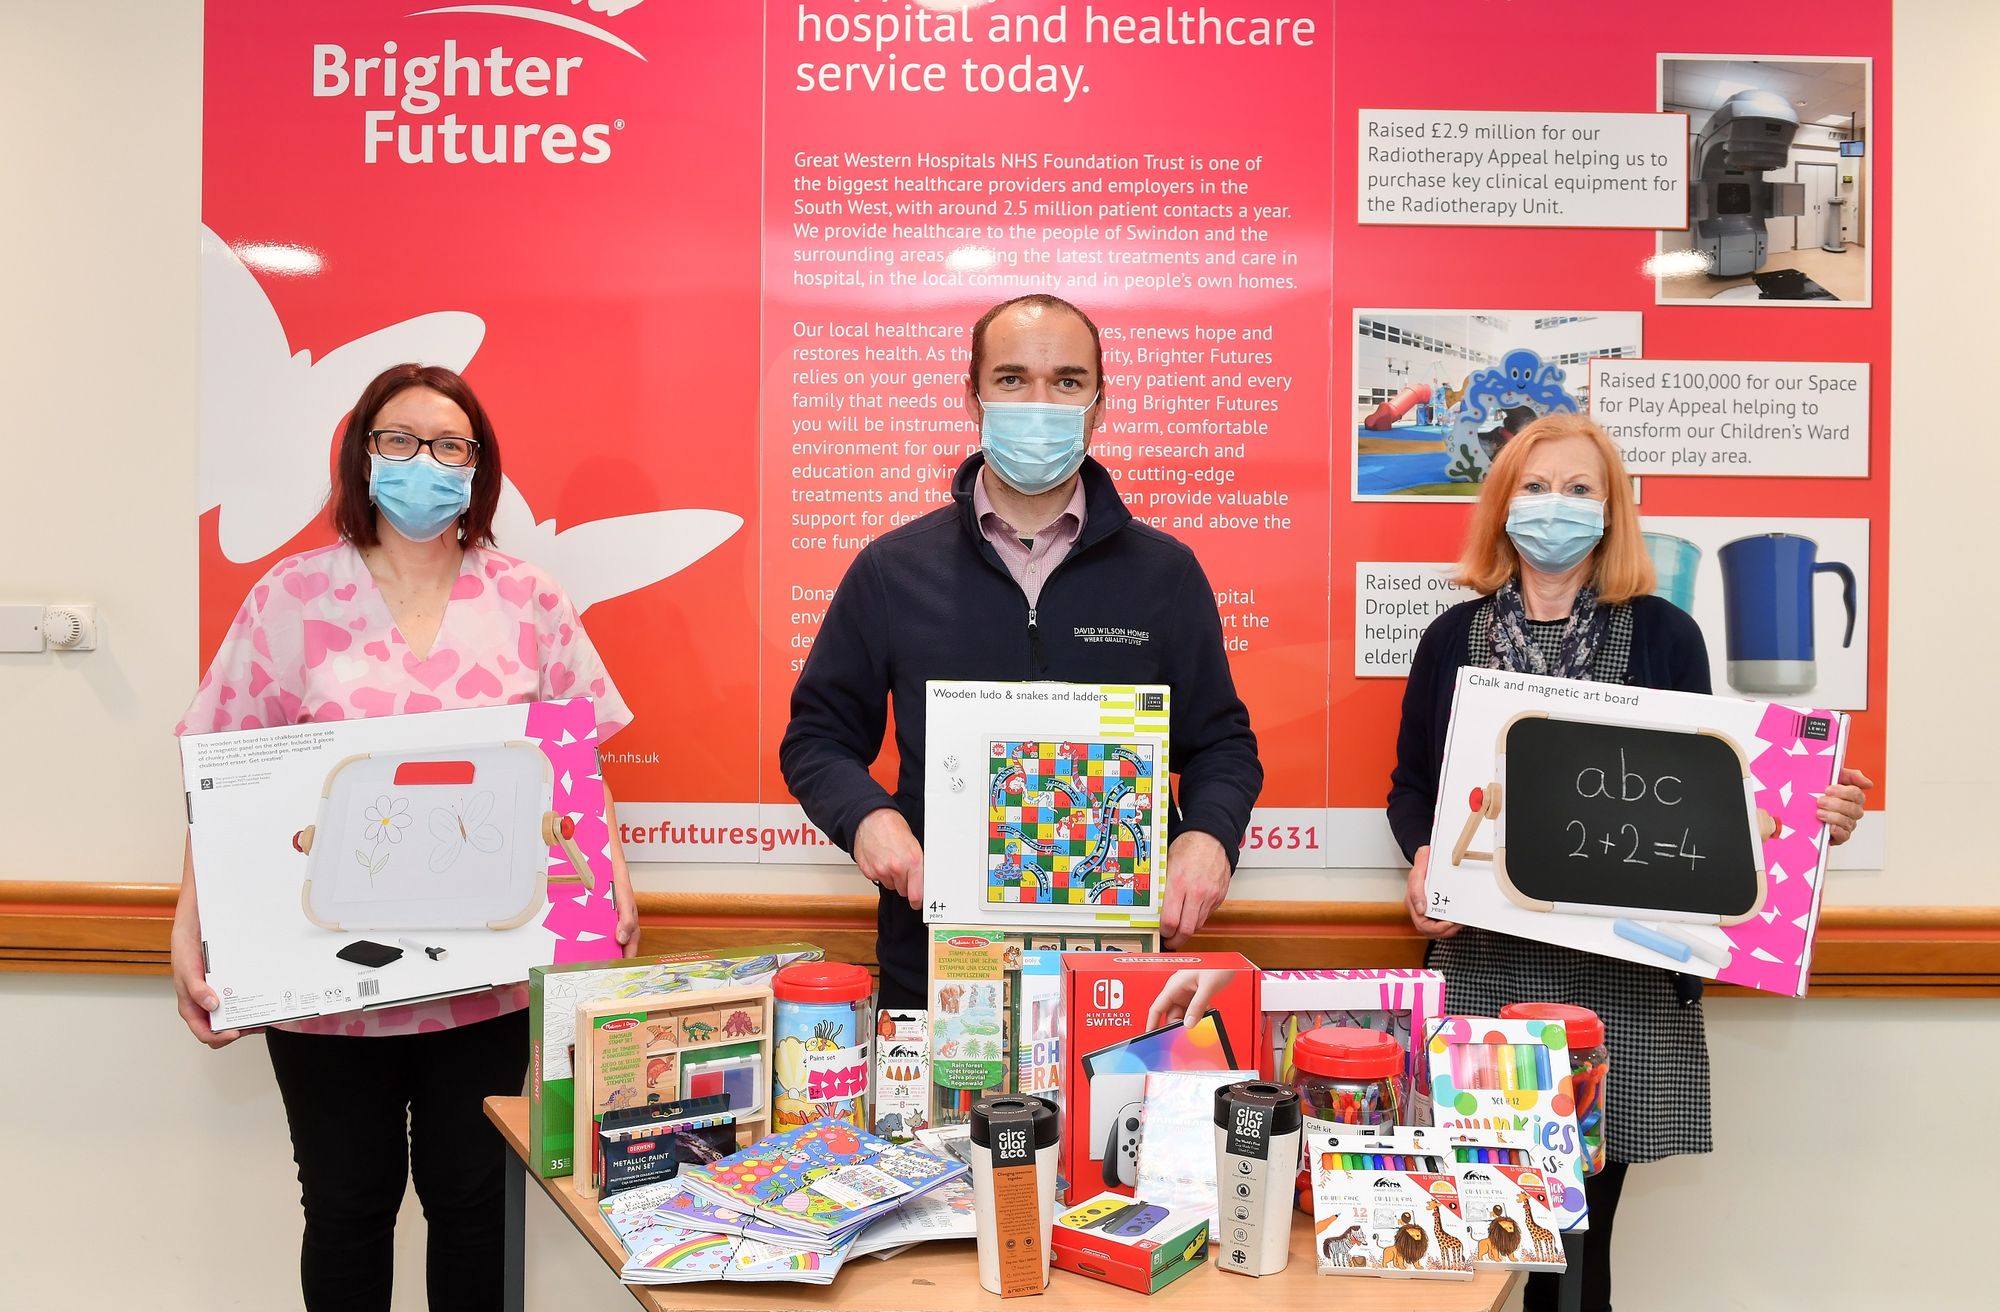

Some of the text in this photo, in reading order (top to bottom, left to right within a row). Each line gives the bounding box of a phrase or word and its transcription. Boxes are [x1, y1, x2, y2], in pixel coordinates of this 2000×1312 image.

[798, 5, 1315, 51] hospital and healthcare
[313, 40, 583, 114] Brighter
[796, 54, 1089, 102] service today.
[1369, 122, 1600, 140] Raised £2.9 million for our
[795, 152, 1262, 171] Great Western Hospitals NHS Foundation Trust is one of
[1369, 147, 1667, 169] Radiotherapy Appeal helping us to
[794, 176, 1248, 197] the biggest healthcare providers and employers in the
[1369, 172, 1677, 193] purchase key clinical equipment for
[1368, 196, 1563, 217] the Radiotherapy Unit.
[794, 322, 963, 337] Our local healthcare
[1131, 325, 1272, 343] renews hope and
[794, 346, 945, 361] restores health. As
[1105, 348, 1272, 366] rity, Brighter Futures
[1601, 372, 1856, 394] Raised £100,000 for our Space
[1600, 397, 1818, 418] for Play Appeal helping to
[1688, 427, 1715, 438] our
[1721, 423, 1802, 439] Children’s
[1808, 425, 1849, 440] Ward
[1619, 446, 1751, 466] tdoor play area.
[1367, 575, 1420, 590] Raised
[1366, 599, 1429, 618] Droplet
[1073, 627, 1150, 638] DAVID WILSON HOMES
[1365, 649, 1413, 664] elderl
[933, 688, 1108, 702] Wooden ludo & snakes and ladders
[1469, 674, 1639, 707] Chalk and magnetic art board
[274, 733, 304, 741] chalkboard
[599, 752, 660, 764] wh.nhs.uk
[1575, 747, 1683, 806] abc
[620, 821, 834, 851] terfuturesgwh.
[929, 901, 947, 912] 4+
[1431, 892, 1451, 907] 3+
[1033, 1040, 1060, 1066] CH
[1034, 1064, 1060, 1090] RA
[1237, 1106, 1263, 1121] circ
[998, 1128, 1026, 1142] circ
[1235, 1126, 1261, 1139] &co.
[1306, 1122, 1333, 1133] Craft kit
[1443, 1114, 1576, 1154] nkies
[630, 1144, 653, 1152] DERWENT
[1000, 1149, 1028, 1160] &co.
[551, 1158, 564, 1170] 35
[613, 1152, 669, 1168] METALLIC PAINT
[627, 1162, 656, 1173] PAN SET
[1352, 1207, 1368, 1218] 12
